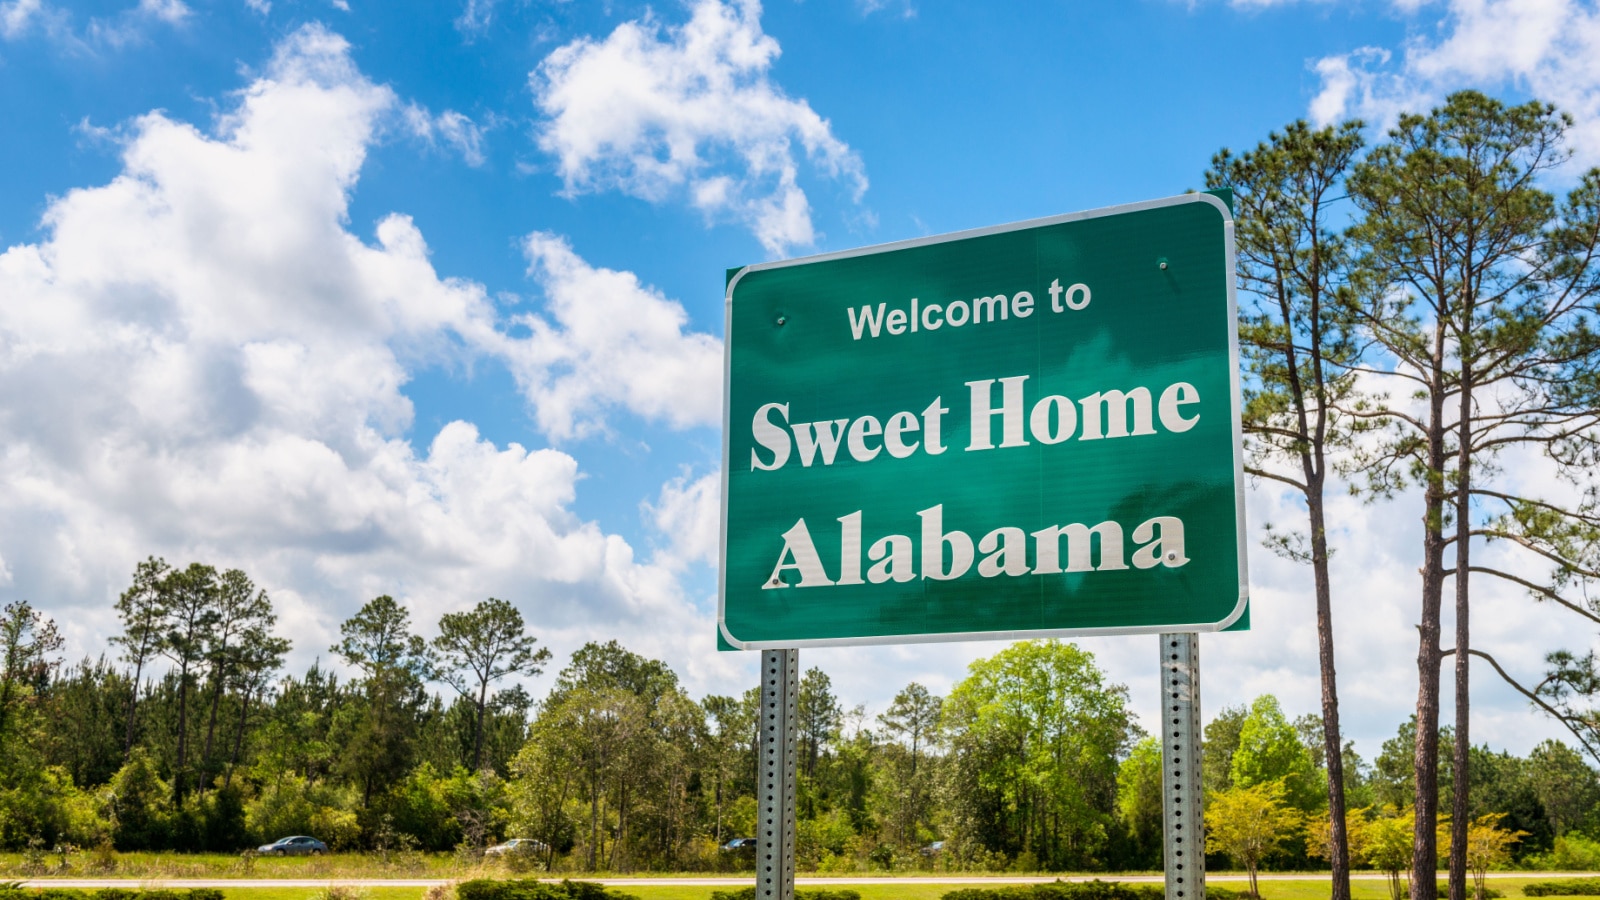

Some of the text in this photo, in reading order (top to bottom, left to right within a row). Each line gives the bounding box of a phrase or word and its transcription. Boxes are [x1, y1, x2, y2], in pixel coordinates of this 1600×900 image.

[847, 278, 1092, 340] Welcome to
[750, 374, 1201, 472] Sweet Home
[761, 503, 1191, 590] Alabama
